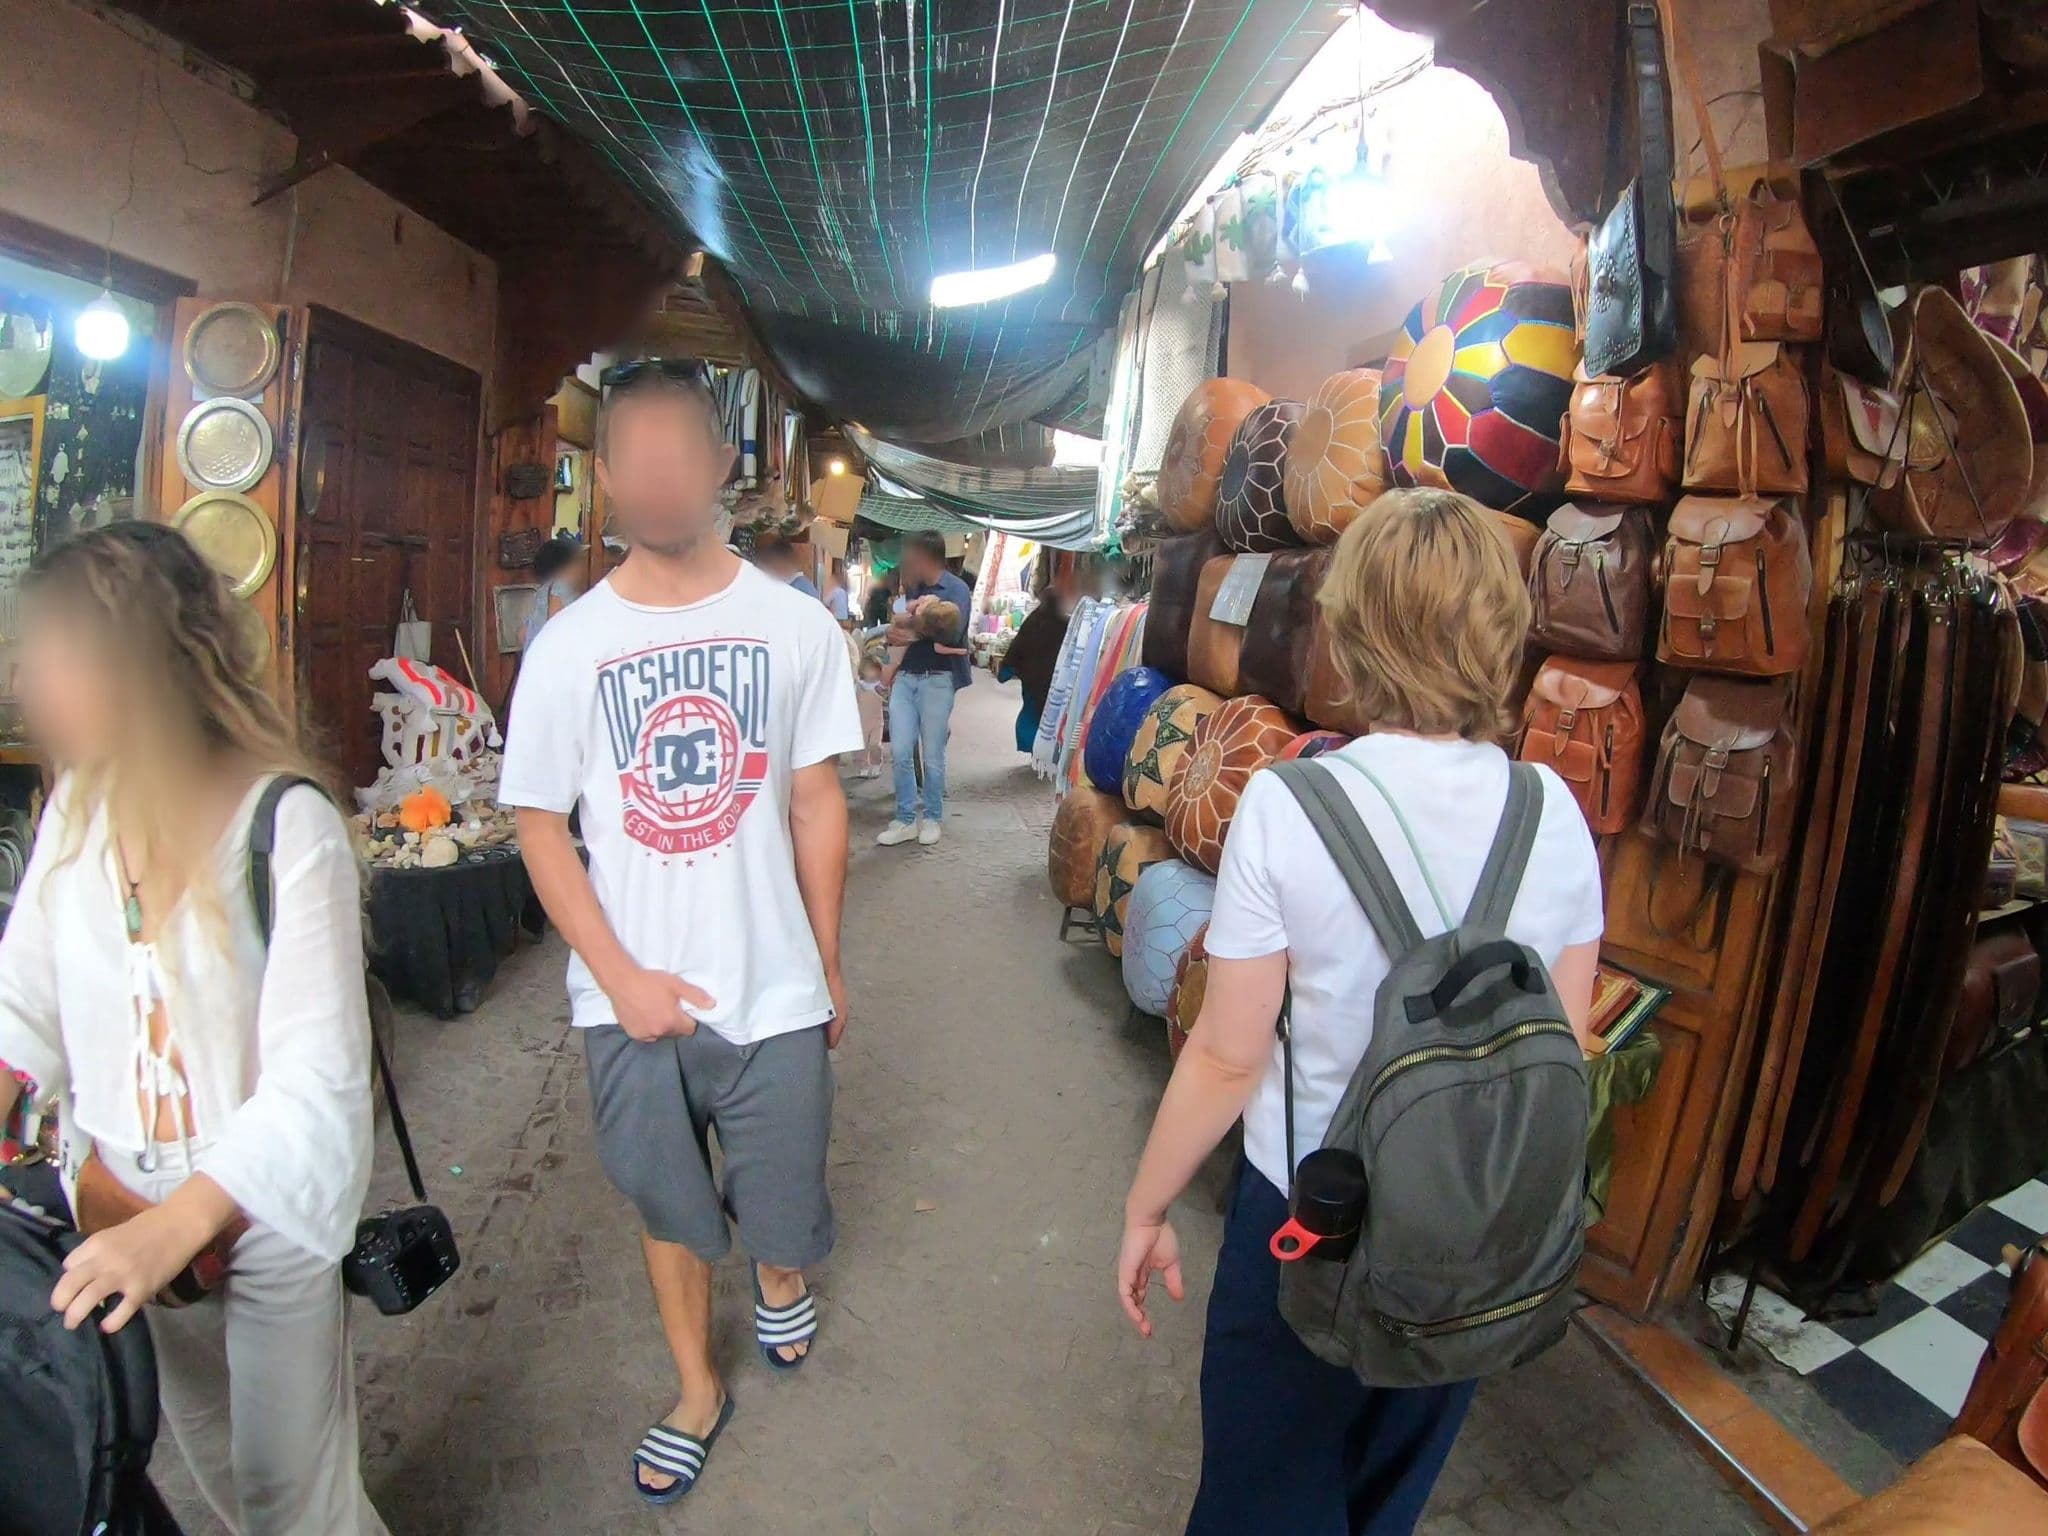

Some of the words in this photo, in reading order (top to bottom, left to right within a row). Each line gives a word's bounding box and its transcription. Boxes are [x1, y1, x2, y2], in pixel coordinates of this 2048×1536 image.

[655, 728, 716, 792] DC
[625, 814, 659, 841] EST
[656, 834, 675, 850] IN
[680, 828, 714, 849] THE
